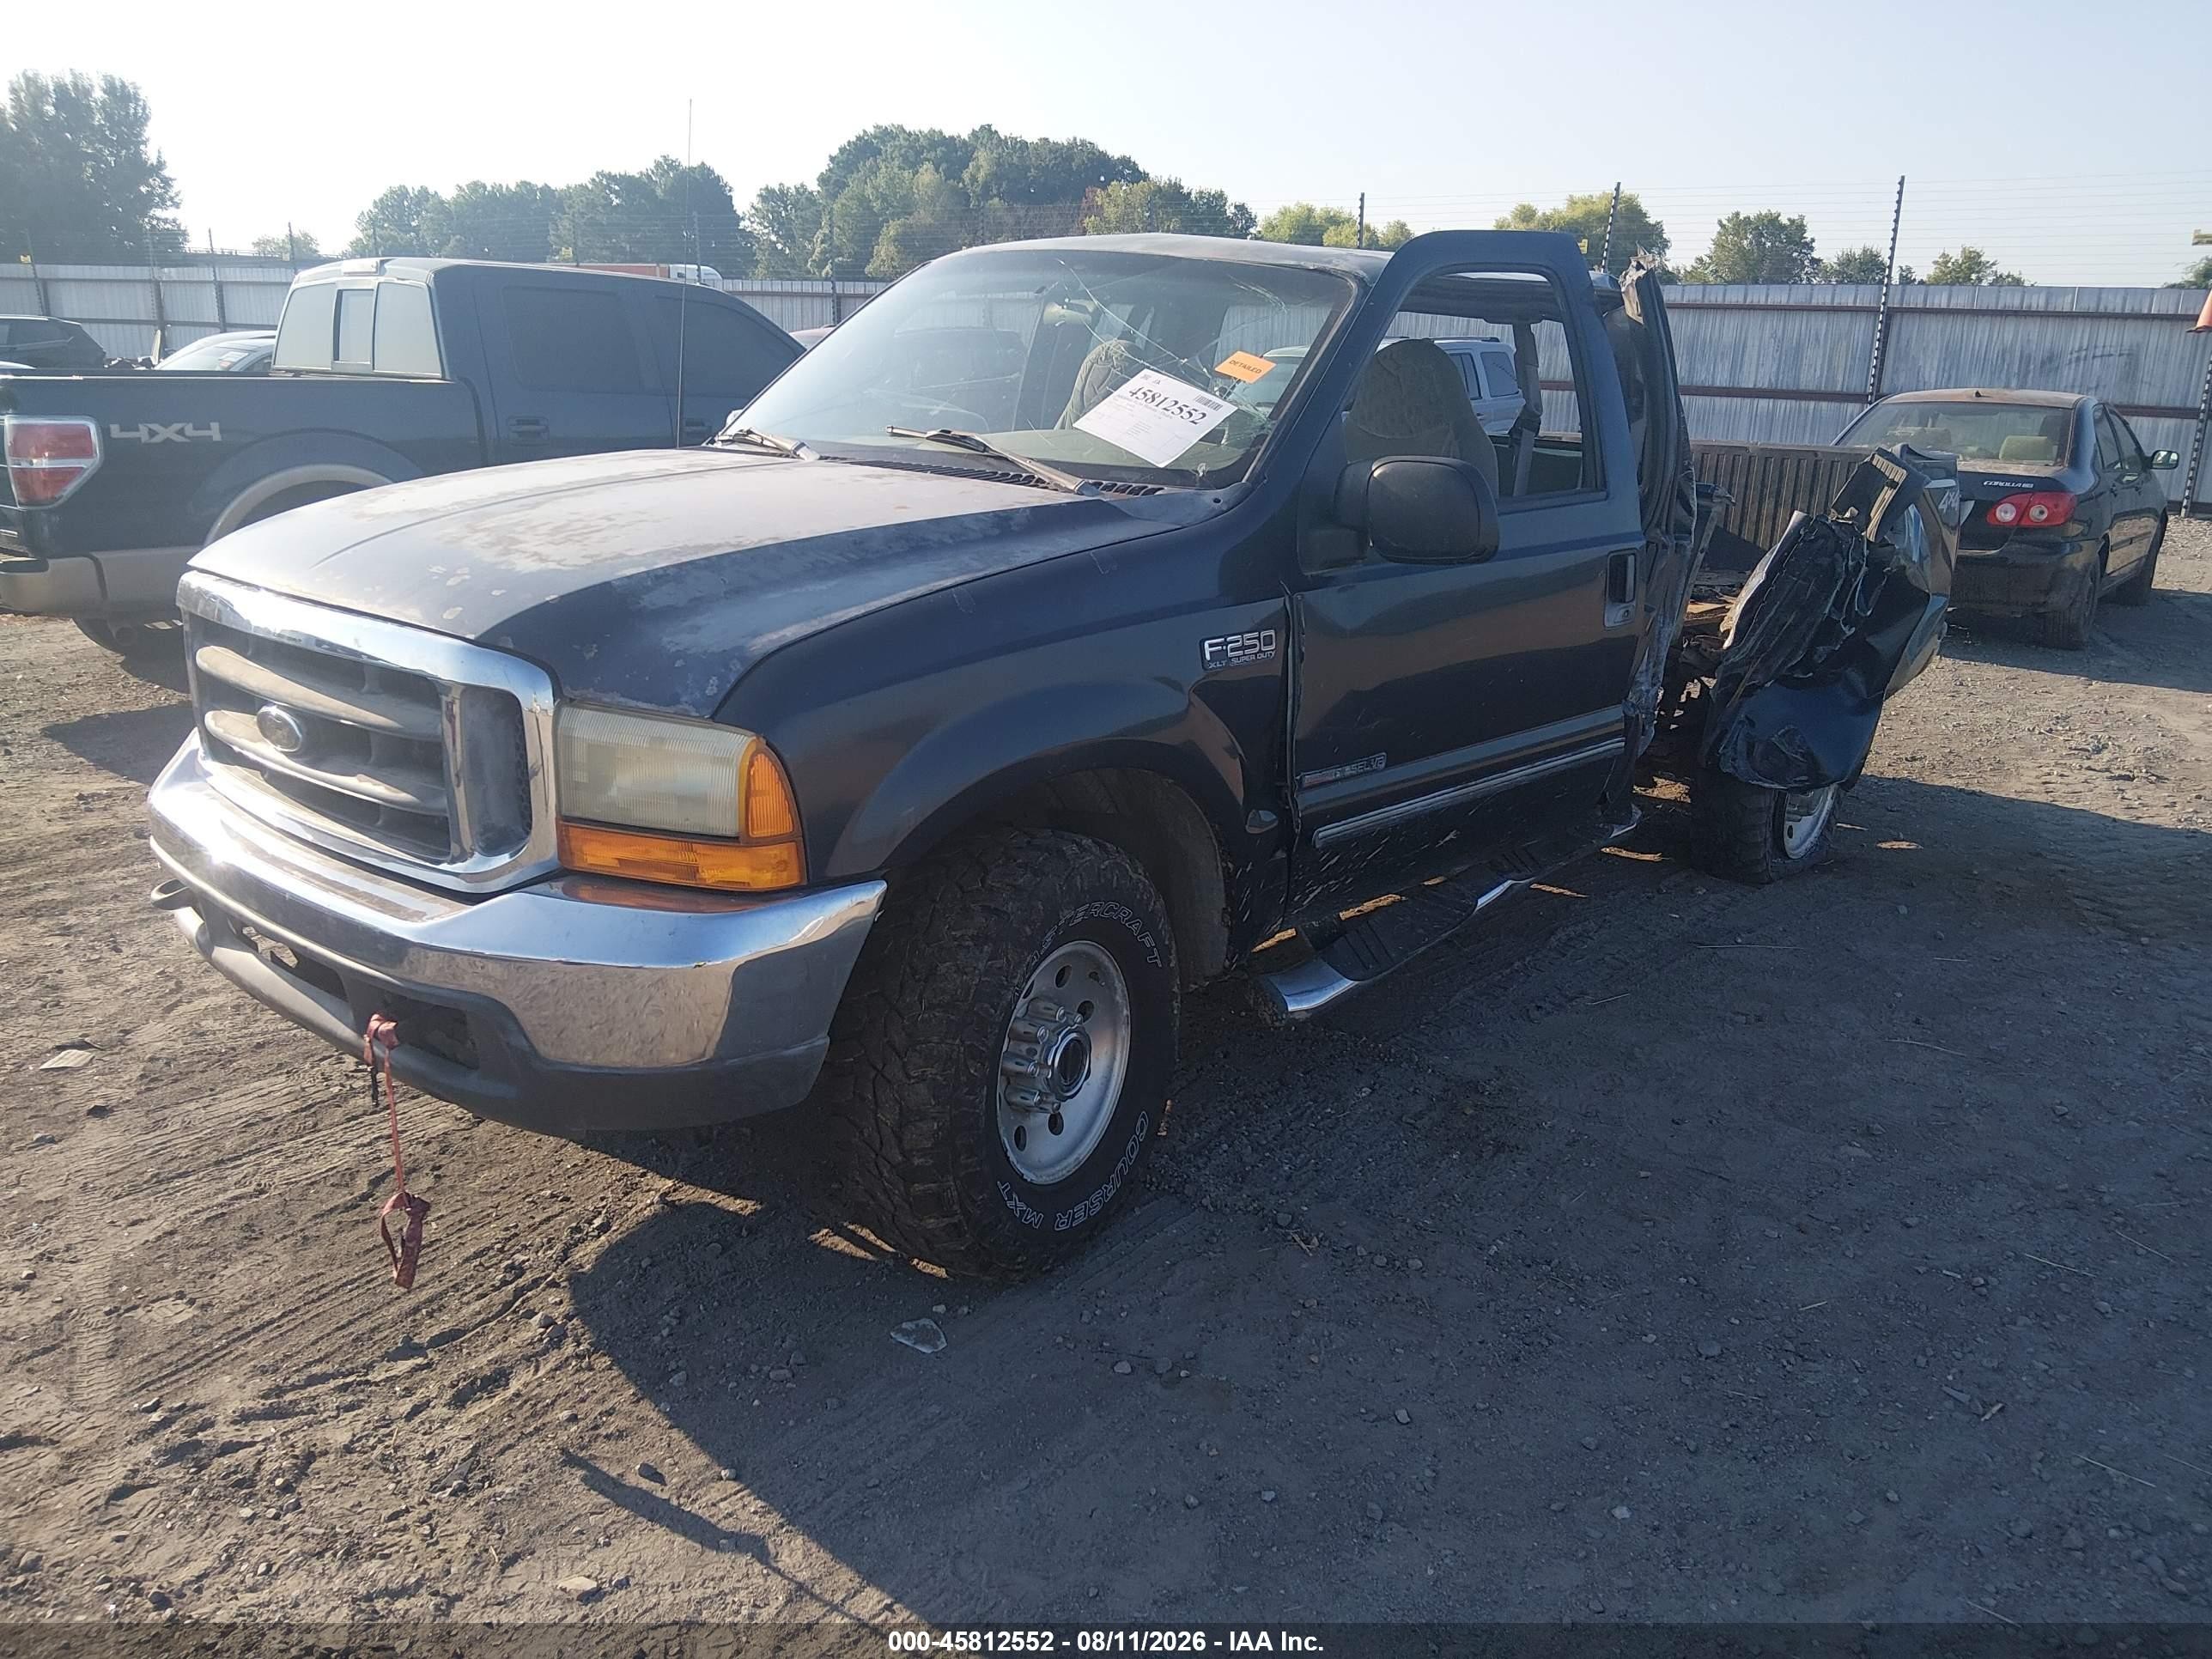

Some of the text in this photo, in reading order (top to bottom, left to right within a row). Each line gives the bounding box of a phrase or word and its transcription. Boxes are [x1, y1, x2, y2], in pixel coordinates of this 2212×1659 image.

[1229, 360, 1262, 374] DETAILED
[1128, 386, 1208, 426] 45812552
[110, 422, 222, 444] 4X4
[1209, 659, 1228, 669] XLT
[1231, 650, 1276, 664] SUPER DUTY
[997, 1111, 1149, 1231] COURSER MXT
